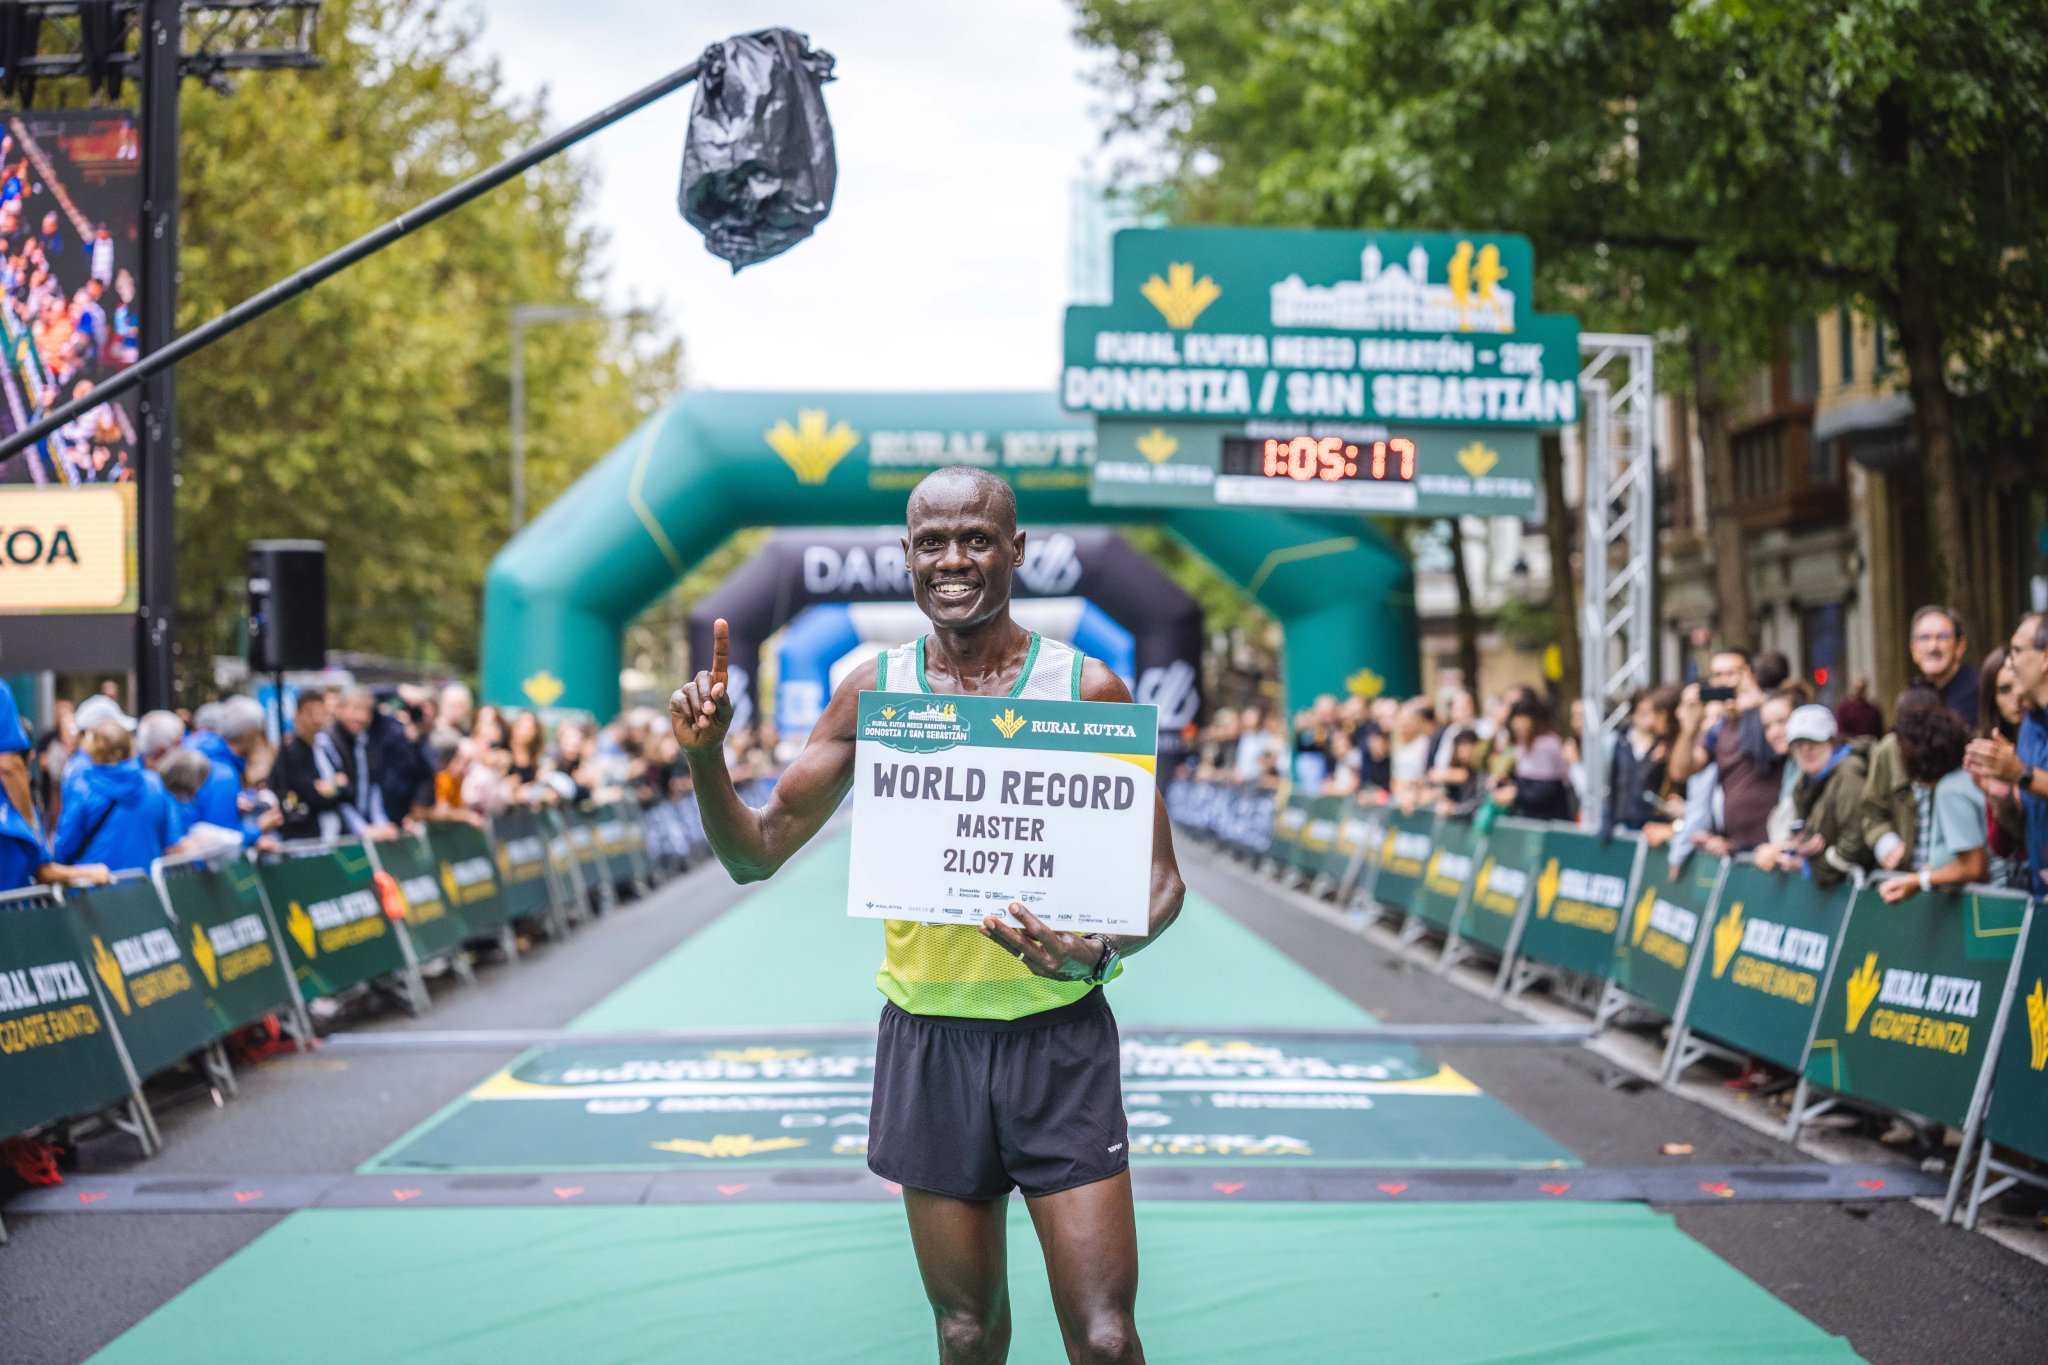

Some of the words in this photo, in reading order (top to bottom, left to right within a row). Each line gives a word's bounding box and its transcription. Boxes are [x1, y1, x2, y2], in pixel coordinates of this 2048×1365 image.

[1095, 331, 1181, 365] RURAL
[1183, 334, 1269, 367] KUTXA
[1065, 366, 1251, 413] DONOSTIA
[1286, 371, 1364, 416] SAN
[1372, 366, 1576, 421] SEBASTIÁN
[870, 430, 998, 467] RURAL
[1263, 436, 1415, 481] 1:05:17
[0, 530, 79, 565] OA
[804, 545, 912, 594] DAR
[865, 727, 902, 737] DONOSTIA
[909, 730, 924, 739] SAN
[926, 731, 967, 741] SEBASTIÁN
[1031, 720, 1080, 734] RURAL
[1083, 723, 1136, 737] KUTXA
[873, 763, 986, 801] WORLD
[1000, 770, 1134, 810] RECORD
[956, 813, 1045, 841] MASTER
[943, 848, 1014, 875] 21,097
[1023, 853, 1054, 878] KM
[28, 960, 89, 1004] KUTXA
[1878, 968, 1929, 1009] RURAL
[1925, 974, 1981, 1018] KUTXA
